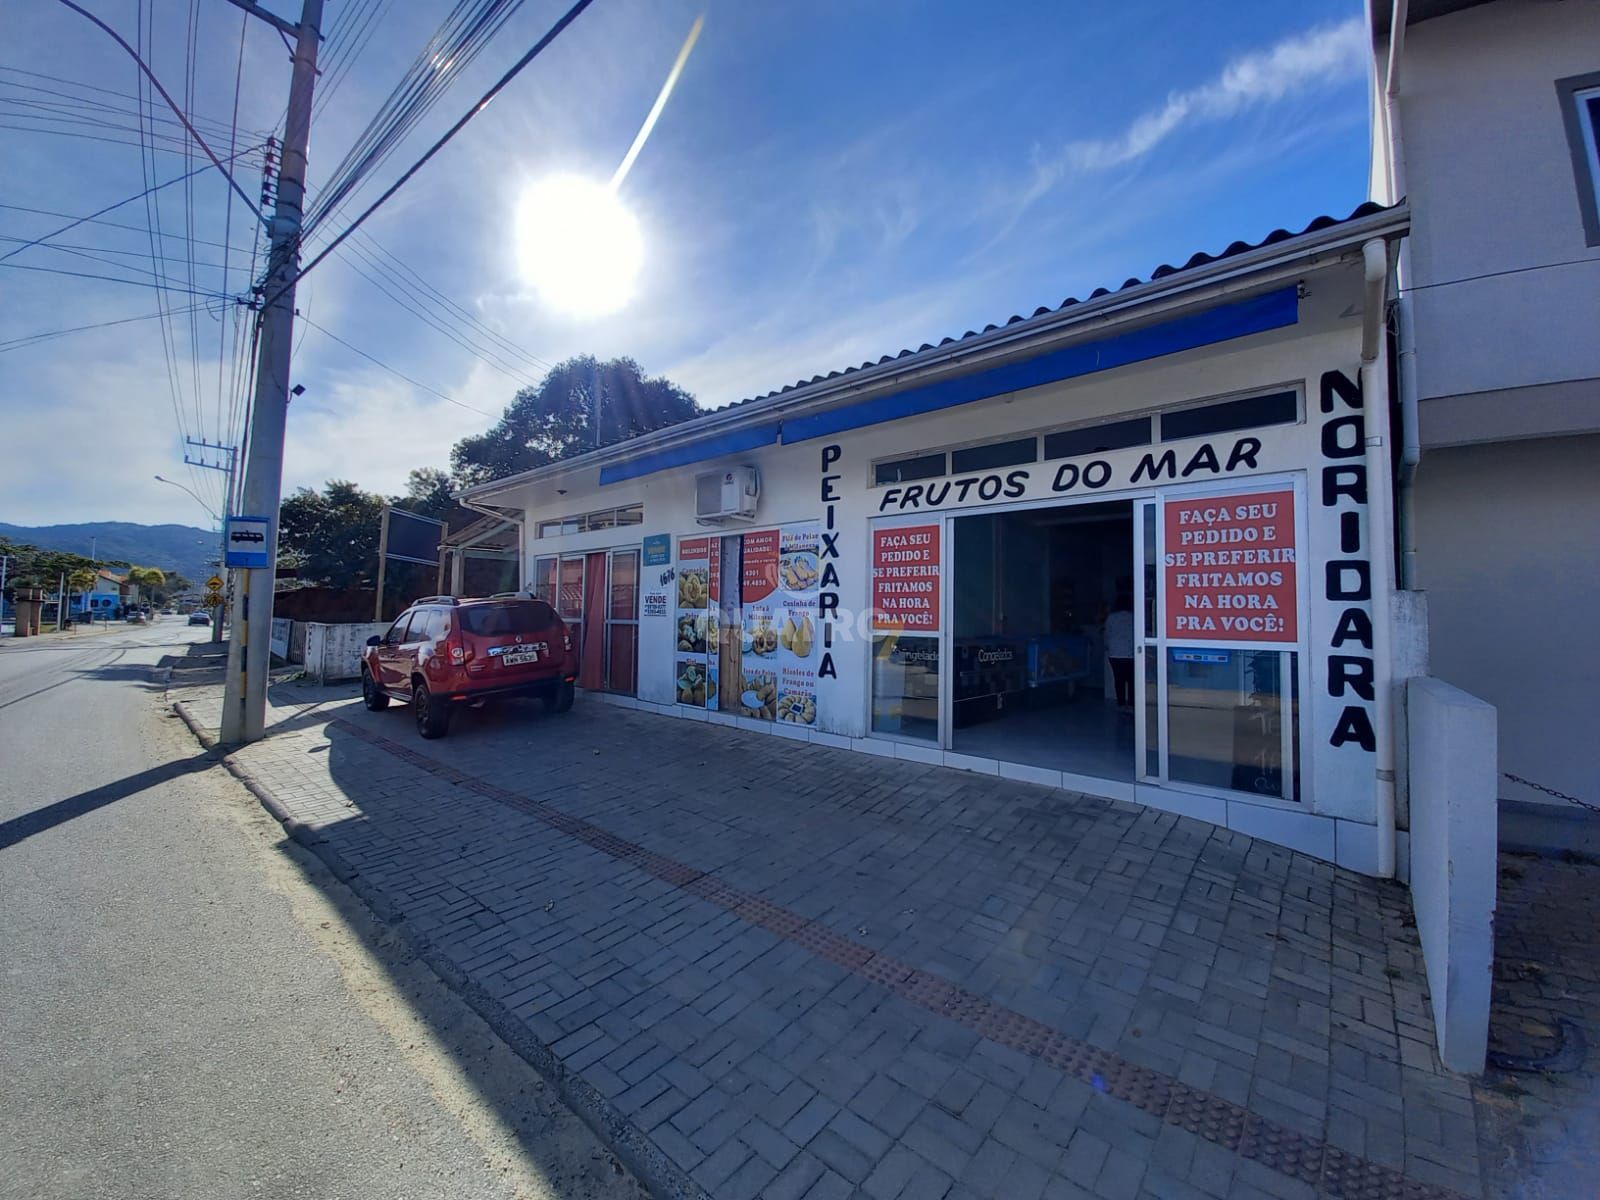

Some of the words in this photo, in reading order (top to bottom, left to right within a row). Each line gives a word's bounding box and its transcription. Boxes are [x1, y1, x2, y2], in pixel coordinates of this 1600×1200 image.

[879, 469, 1030, 511] FRUTOS
[1052, 459, 1112, 491] DO
[1129, 437, 1262, 483] MAR
[1180, 507, 1231, 526] FAÇA
[1235, 503, 1277, 520] SEU
[880, 535, 908, 549] FAÇA
[909, 533, 931, 545] SEU
[1181, 527, 1258, 545] PEDIDO
[1263, 526, 1276, 541] E
[818, 444, 841, 680] PEIXARIA
[881, 550, 921, 562] PEDIDO
[923, 550, 930, 560] E
[1165, 552, 1187, 567] SE
[1190, 547, 1296, 566] PREFERIR
[1320, 366, 1377, 753] NORIDARA
[872, 567, 884, 578] SE
[886, 565, 939, 577] PREFERIR
[1176, 571, 1283, 588] FRITAMOS
[878, 581, 933, 593] FRITAMOS
[644, 595, 667, 604] VENDE
[882, 598, 897, 609] NA
[899, 598, 930, 609] HORA
[1184, 594, 1213, 609] NA
[1217, 594, 1278, 609] HORA
[877, 613, 898, 624] PRA
[900, 611, 933, 625] VOCÊ!
[1176, 616, 1216, 630] PRA
[1220, 613, 1284, 632] VOCÊ!
